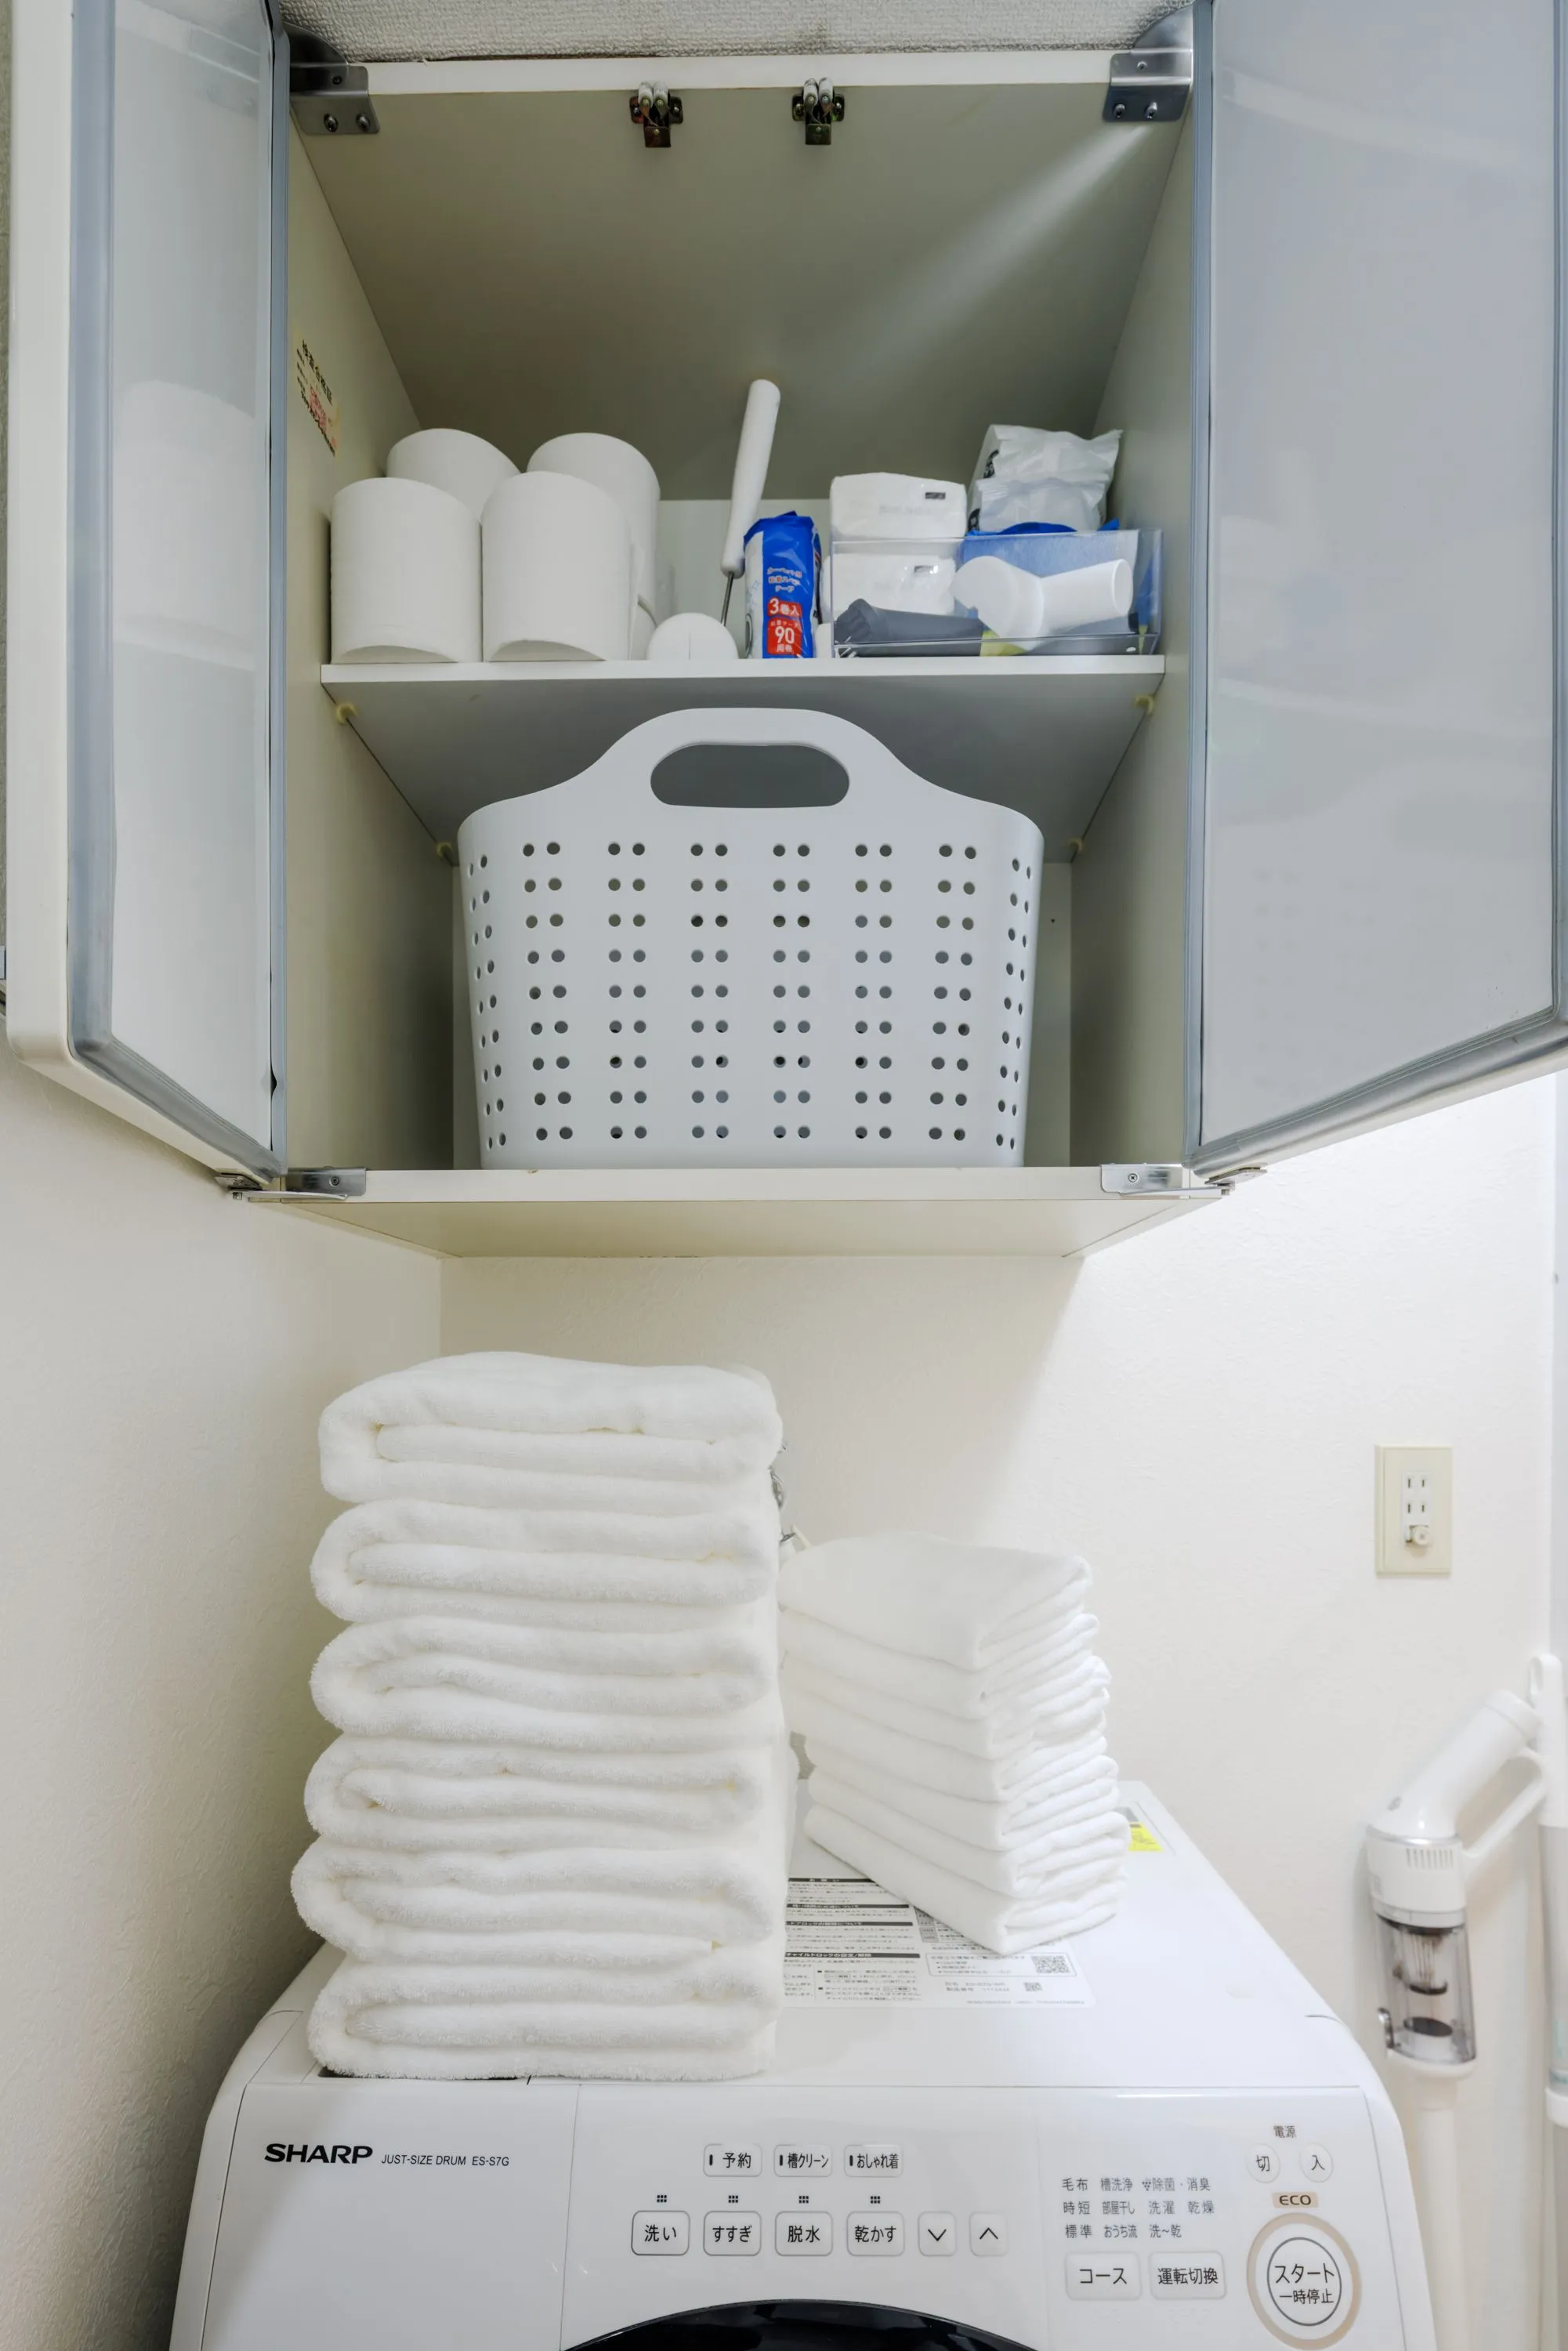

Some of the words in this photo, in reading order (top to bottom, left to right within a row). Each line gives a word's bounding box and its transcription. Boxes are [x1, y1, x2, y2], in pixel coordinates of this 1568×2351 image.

[775, 626, 795, 644] 90
[1273, 2126, 1296, 2138] 電源
[264, 2143, 373, 2164] SHARP
[382, 2154, 433, 2164] JUST-SIZE
[436, 2156, 465, 2165] DRUM
[473, 2157, 509, 2166] ES-S7G
[722, 2153, 751, 2168] 予約
[788, 2153, 828, 2168] 槽クリーン
[857, 2154, 899, 2168] おしゃれ着
[1256, 2156, 1269, 2172] 切
[1312, 2155, 1325, 2171] 入
[1063, 2178, 1088, 2191] 毛布
[1101, 2178, 1132, 2191] 槽洗浄
[1103, 2201, 1135, 2214] 部屋干し
[1188, 2201, 1214, 2214] 乾燥
[1280, 2195, 1311, 2205] ECO
[1063, 2201, 1090, 2215] 時短
[1149, 2201, 1174, 2215] 洗濯
[645, 2224, 676, 2241] 洗い
[712, 2226, 751, 2242] すすぎ
[788, 2226, 820, 2243] 脱水
[855, 2226, 896, 2243] 乾かす
[1066, 2225, 1092, 2238] 標準
[1104, 2225, 1137, 2238] おうち流
[1080, 2268, 1127, 2284] コース
[1158, 2268, 1218, 2284] 運転切換
[1274, 2262, 1334, 2284] スタート
[1280, 2288, 1334, 2305] 一時停止
